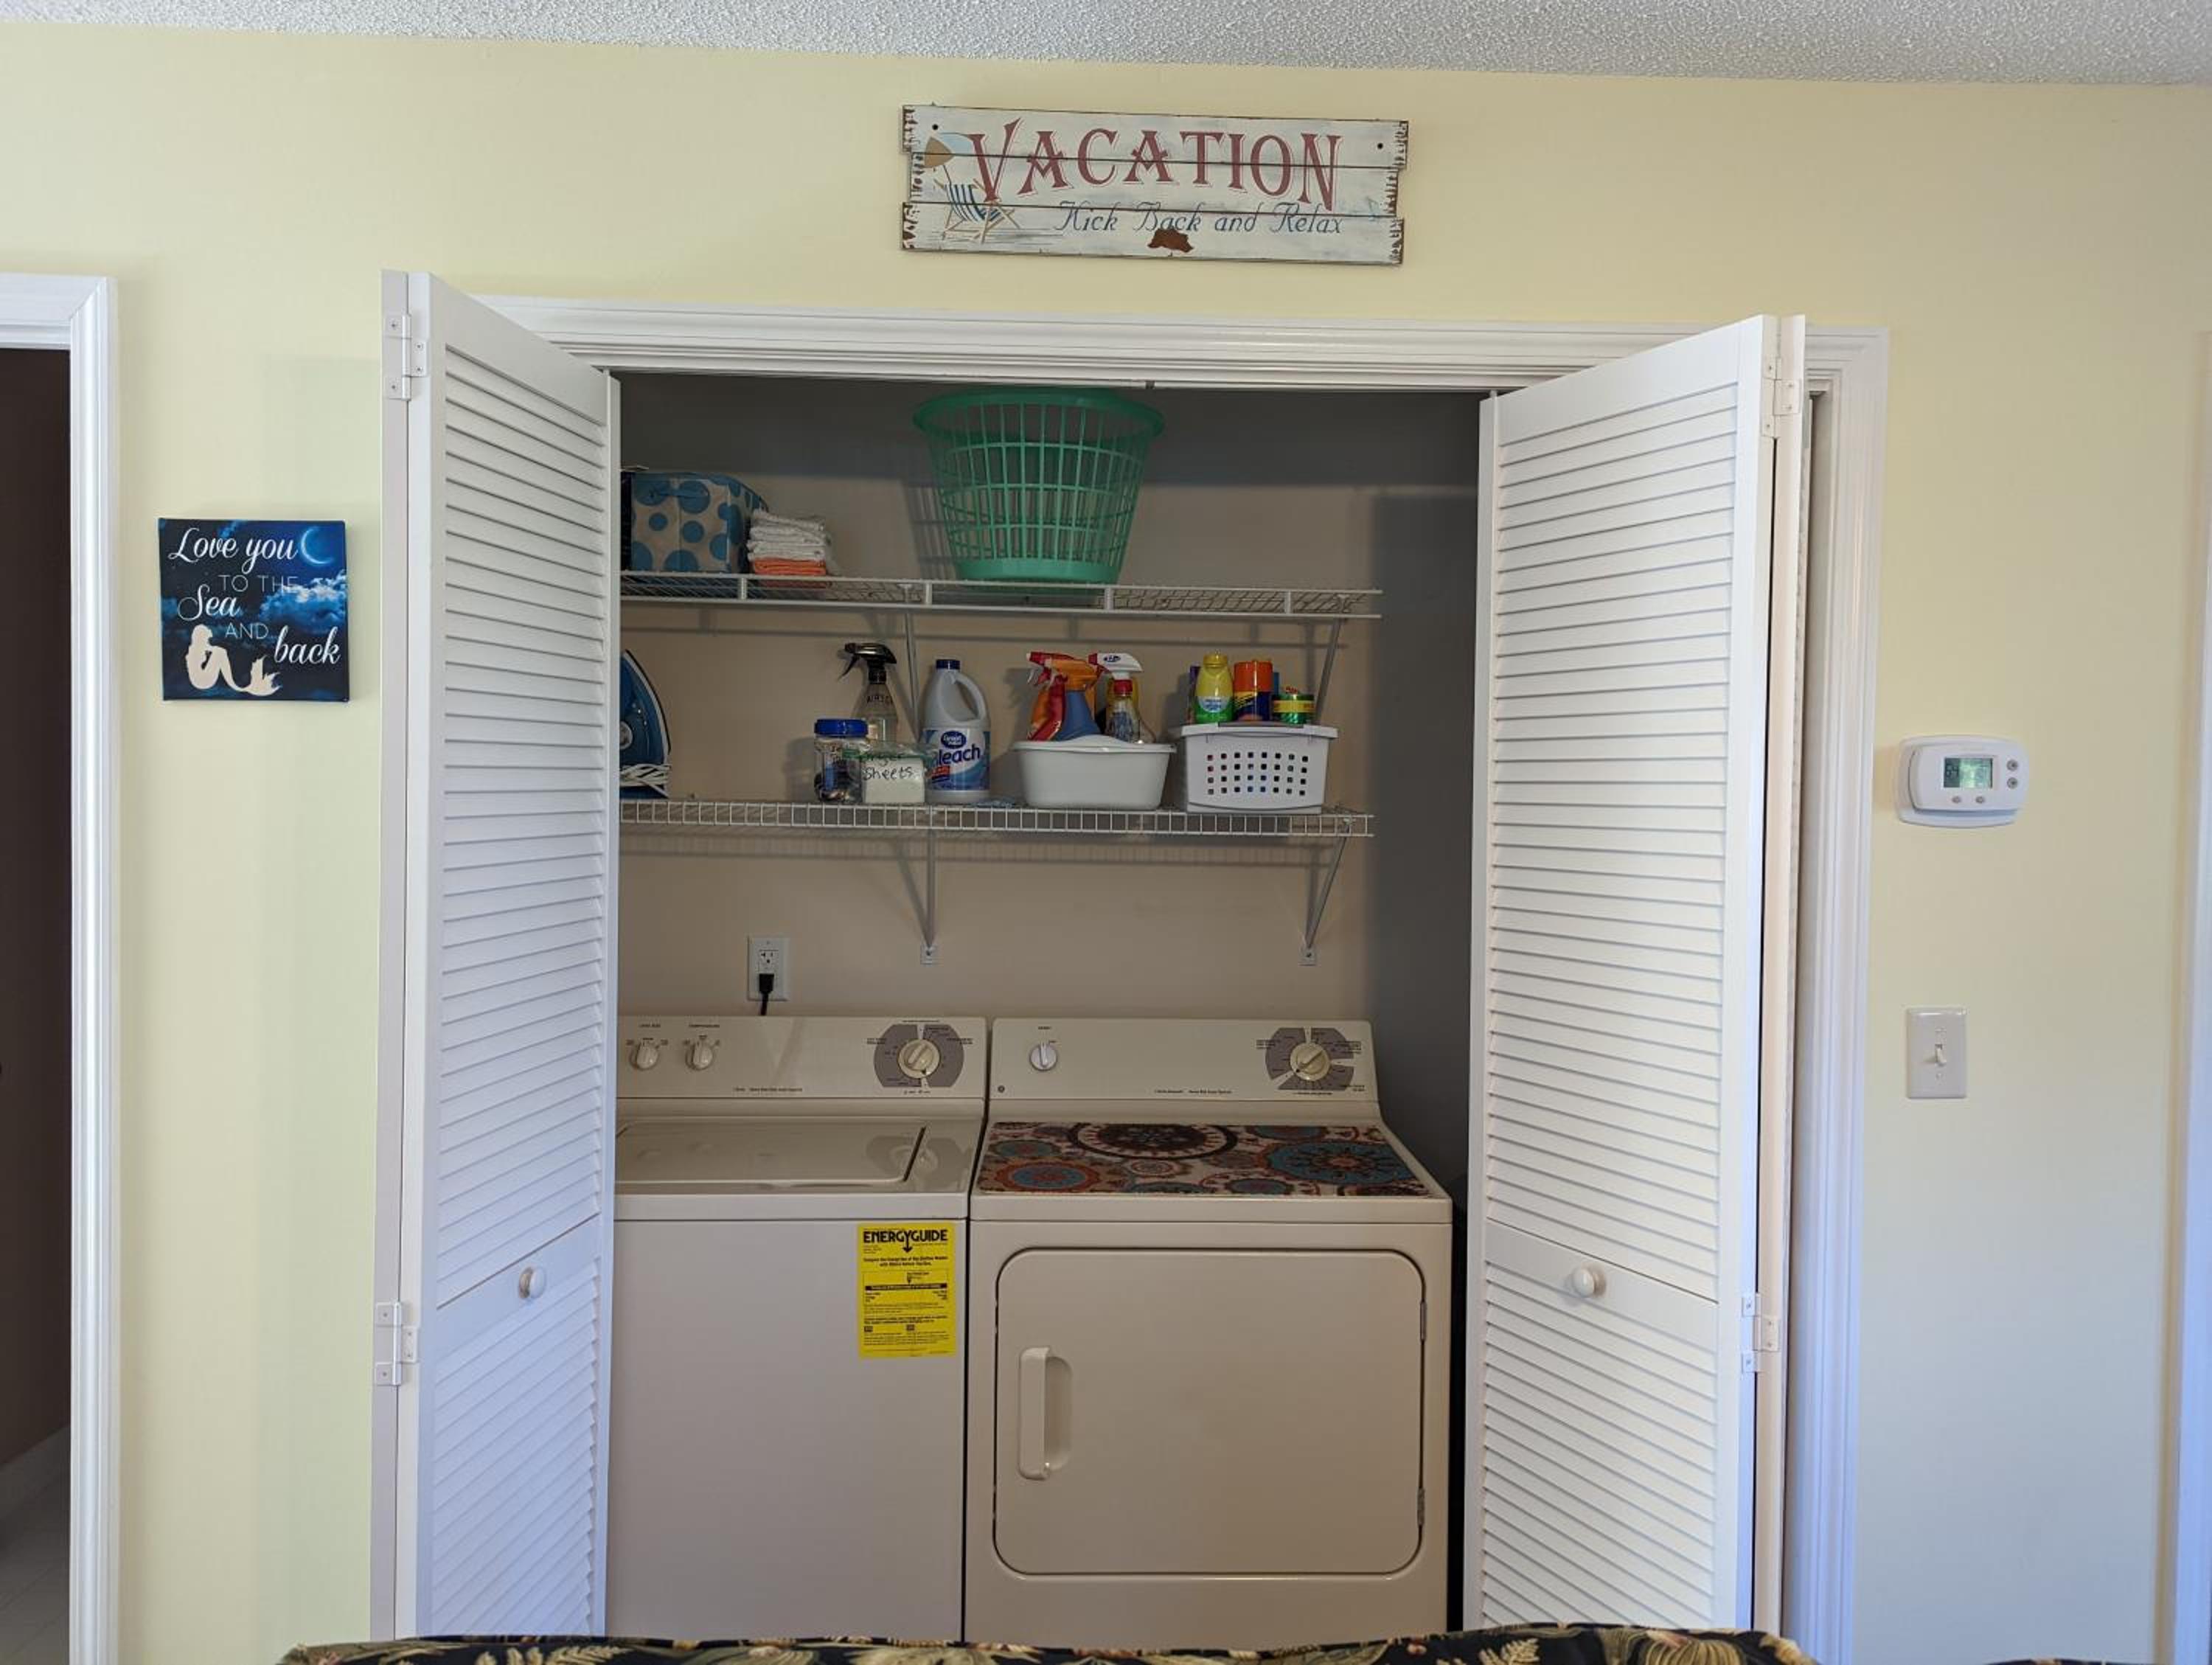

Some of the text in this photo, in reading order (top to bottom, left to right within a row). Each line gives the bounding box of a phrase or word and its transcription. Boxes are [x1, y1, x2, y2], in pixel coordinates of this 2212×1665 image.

[970, 117, 1343, 211] VACATION
[1055, 201, 1344, 234] Kick Back and Relax
[168, 527, 299, 575] Love you
[218, 574, 299, 593] TO THE
[178, 584, 241, 621] Sea
[225, 622, 269, 640] AND
[274, 625, 341, 664] back
[861, 766, 914, 781] Sheets
[863, 1229, 948, 1245] ENERGYGUIDE
